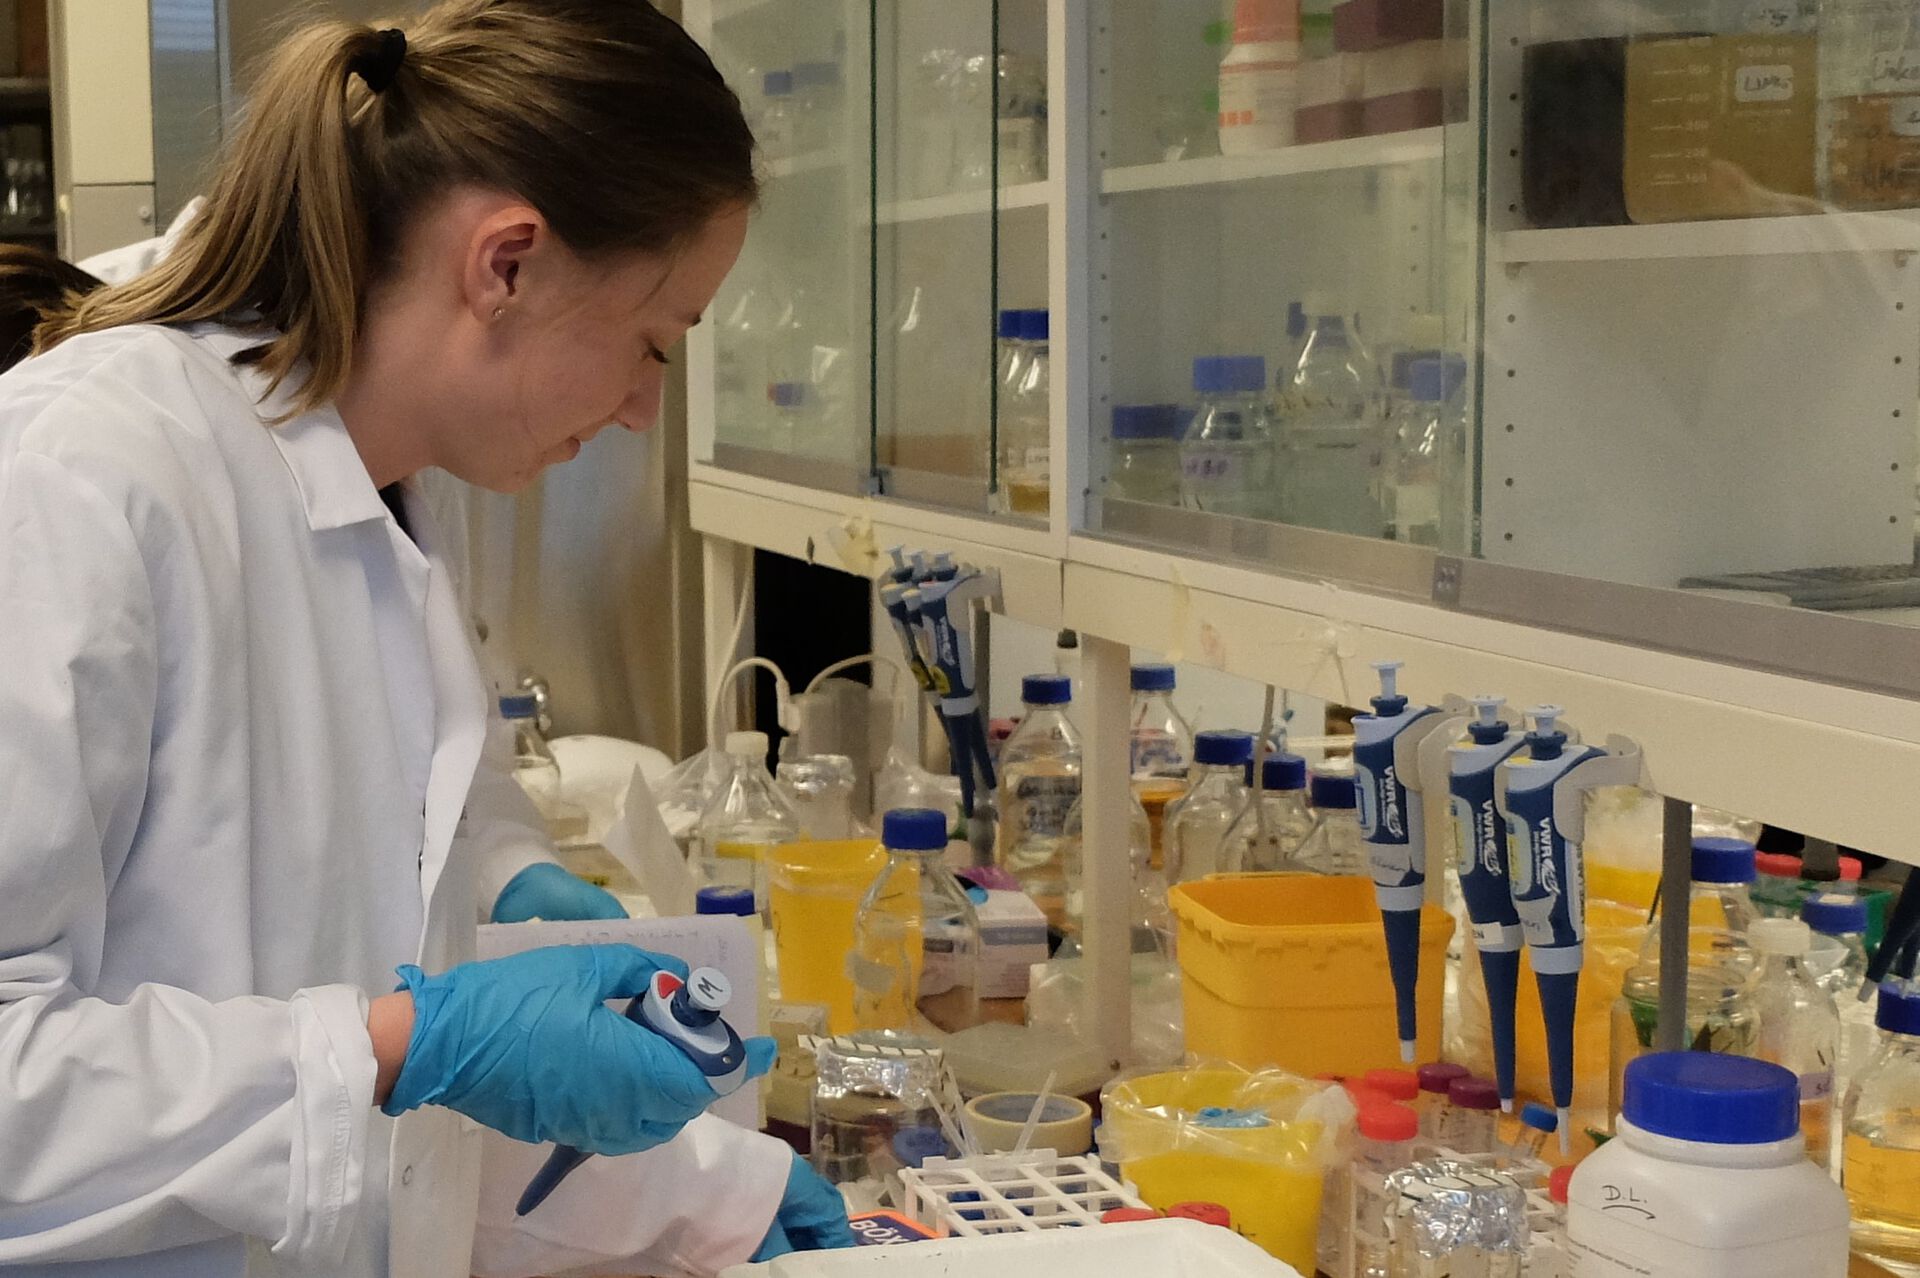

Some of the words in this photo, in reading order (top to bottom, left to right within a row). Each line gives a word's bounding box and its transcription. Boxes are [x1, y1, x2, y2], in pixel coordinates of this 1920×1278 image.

[1384, 765, 1397, 803] VWR
[1482, 799, 1496, 839] VWR
[1539, 817, 1553, 858] VWR
